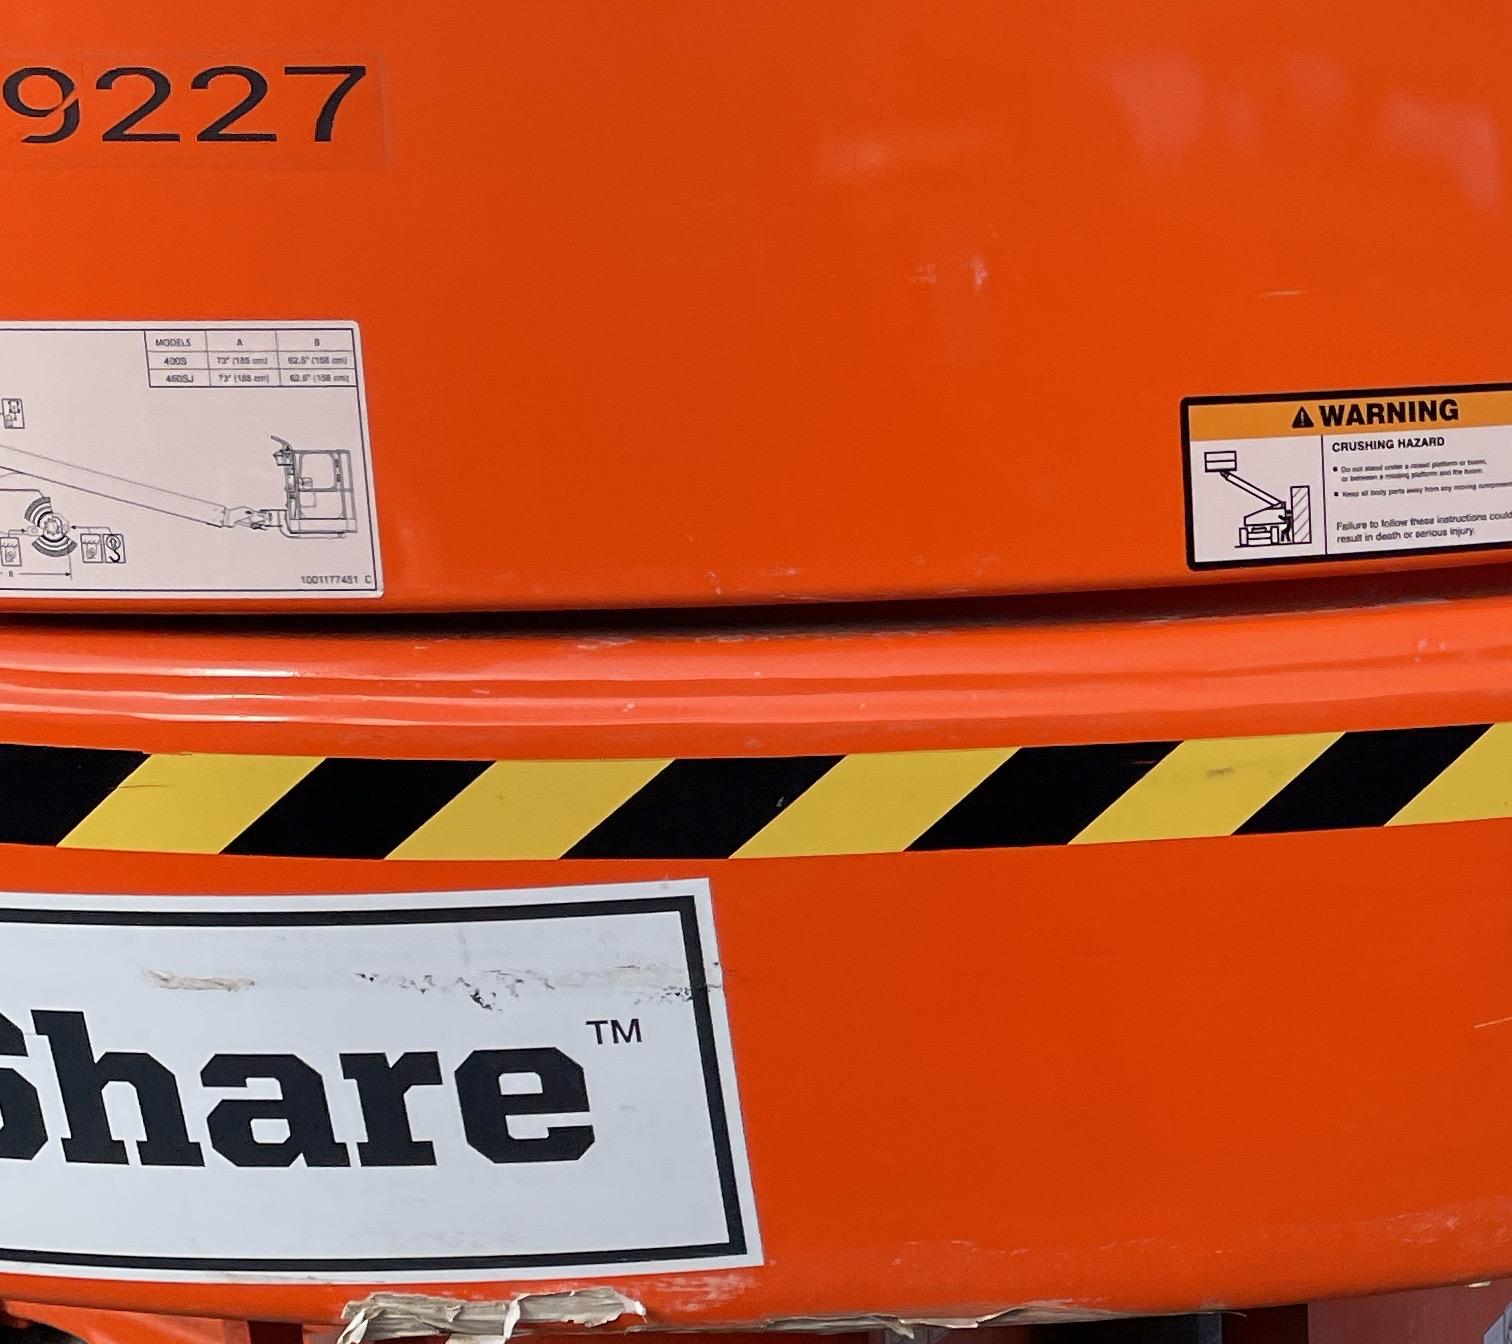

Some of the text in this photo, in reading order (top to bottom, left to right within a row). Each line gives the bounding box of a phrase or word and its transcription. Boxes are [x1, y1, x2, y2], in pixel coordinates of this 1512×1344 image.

[2, 65, 367, 144] 9227
[1319, 399, 1459, 428] WARNING
[1332, 437, 1445, 452] CRUSHING HAZARD
[1337, 511, 1512, 530] Failure to follow these instructions could
[1337, 534, 1362, 543] result
[1365, 533, 1373, 541] in
[1376, 531, 1401, 540] death
[1415, 529, 1447, 538] serious
[364, 574, 372, 584] C
